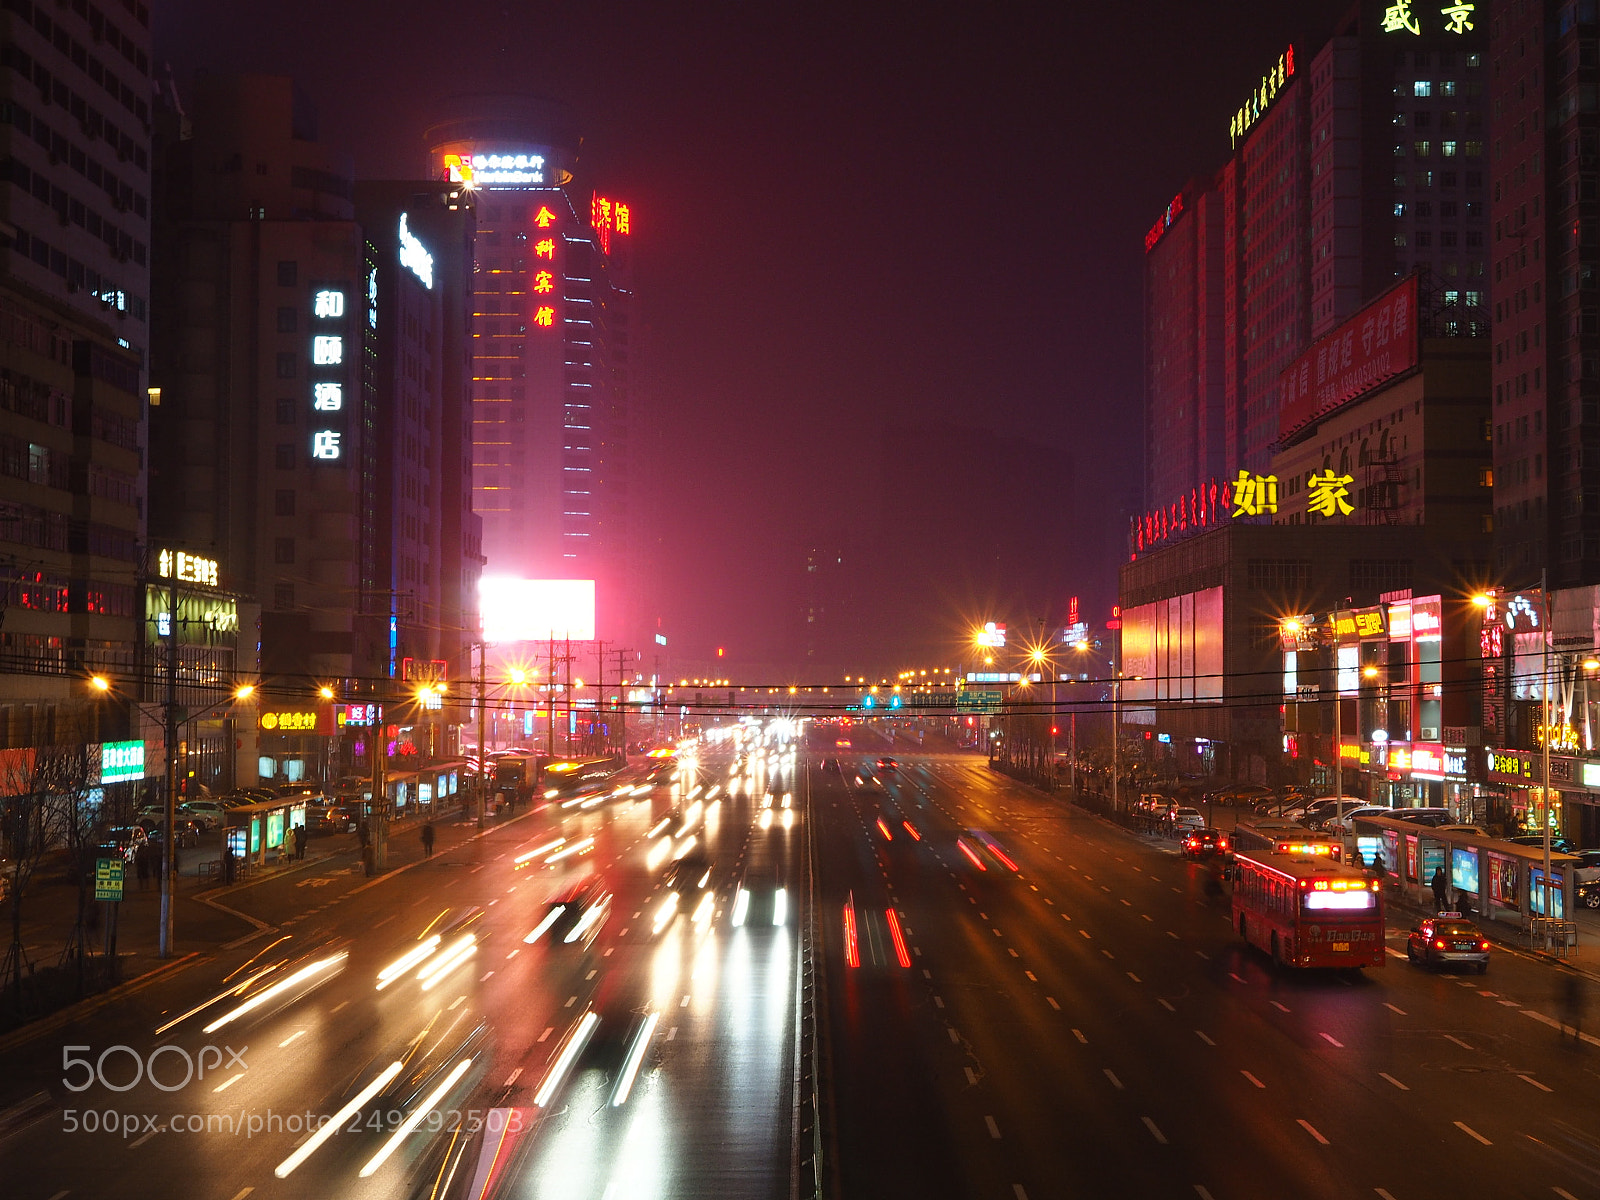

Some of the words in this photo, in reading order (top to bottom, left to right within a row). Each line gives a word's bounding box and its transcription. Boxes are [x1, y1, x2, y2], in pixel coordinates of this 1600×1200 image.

[1381, 0, 1474, 35] 盛京
[534, 206, 556, 327] 金科宾馆
[313, 291, 344, 459] 和颐酒店
[1232, 469, 1355, 518] 如家
